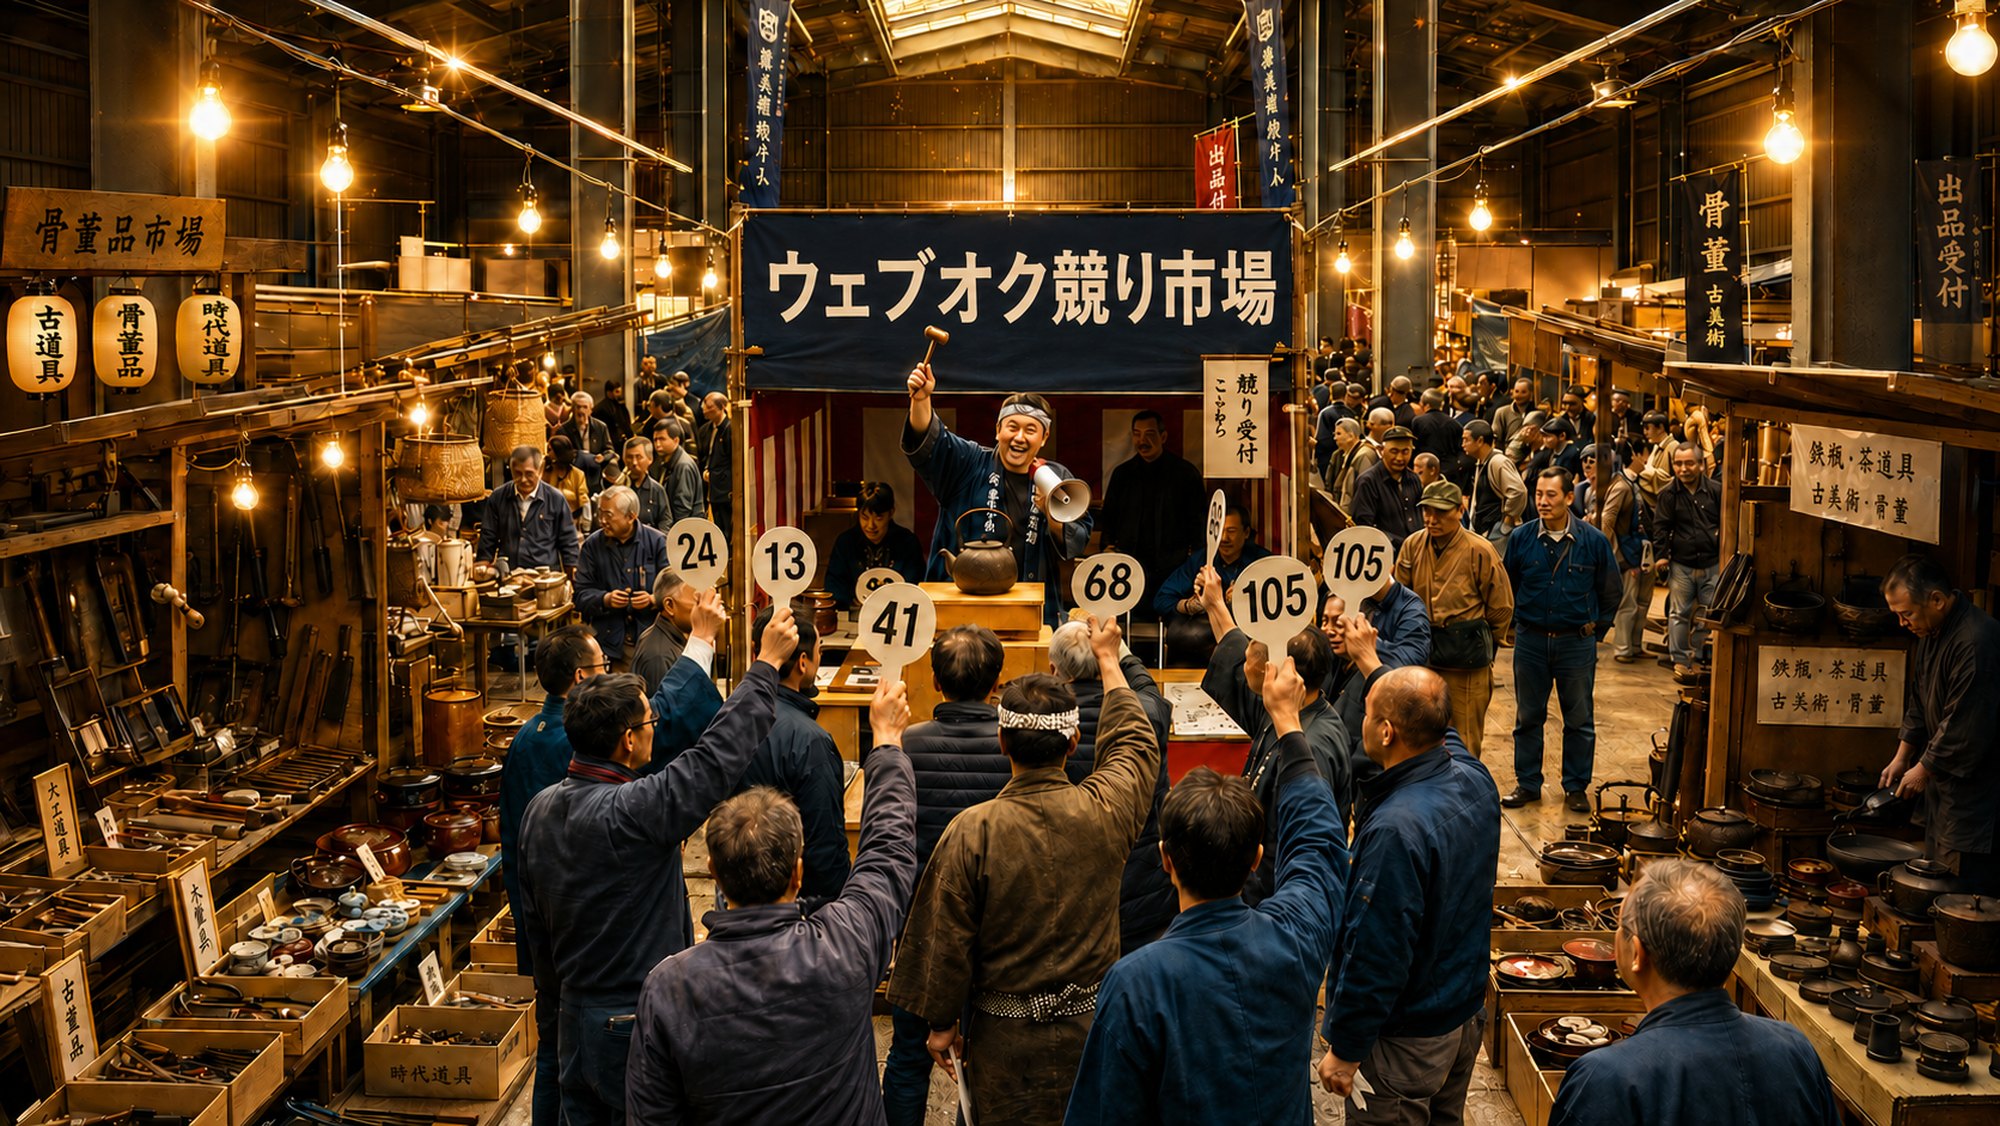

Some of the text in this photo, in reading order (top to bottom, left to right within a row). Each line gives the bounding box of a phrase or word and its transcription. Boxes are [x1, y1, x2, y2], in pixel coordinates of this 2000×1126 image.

[36, 207, 204, 257] 骨董品市場
[1936, 173, 1969, 309] 出品受付
[768, 246, 1278, 327] ウェブオク競り市場
[1699, 190, 1730, 348] 骨董 古美術
[35, 305, 64, 384] 古道具
[117, 303, 145, 378] 骨董品
[202, 300, 231, 376] 時代道具
[677, 532, 717, 570] 24
[765, 542, 806, 581] 13
[1332, 542, 1385, 582] 105
[1084, 562, 1132, 602] 68
[1242, 573, 1307, 623] 105
[872, 601, 919, 647] 41
[48, 782, 70, 858] 大工道具
[390, 1065, 472, 1085] 時代道具
